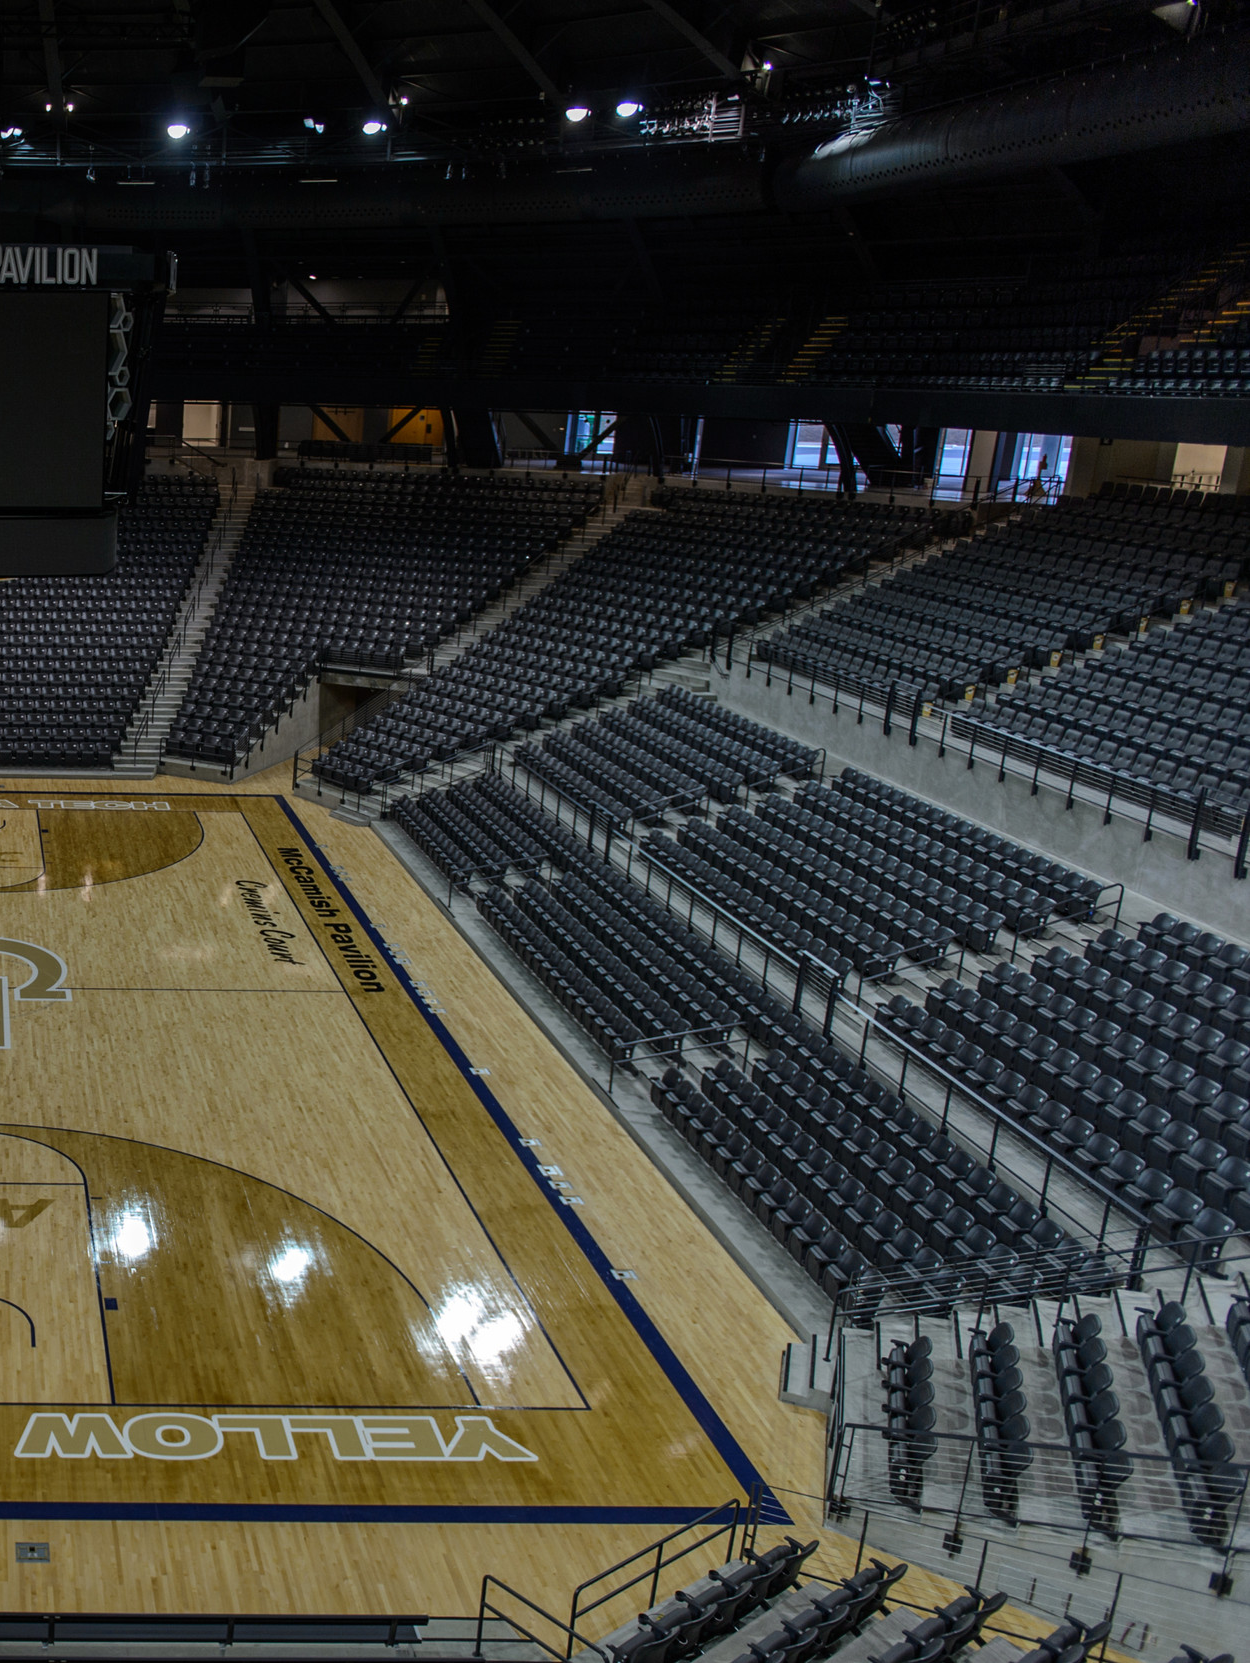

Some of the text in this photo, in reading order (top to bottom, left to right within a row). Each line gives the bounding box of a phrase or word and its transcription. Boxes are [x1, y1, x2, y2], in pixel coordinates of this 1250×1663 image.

[27, 799, 171, 811] TECH
[235, 879, 306, 966] Cremins Court
[277, 847, 385, 993] McCamish Pavilion
[13, 1412, 539, 1462] YELLOW
